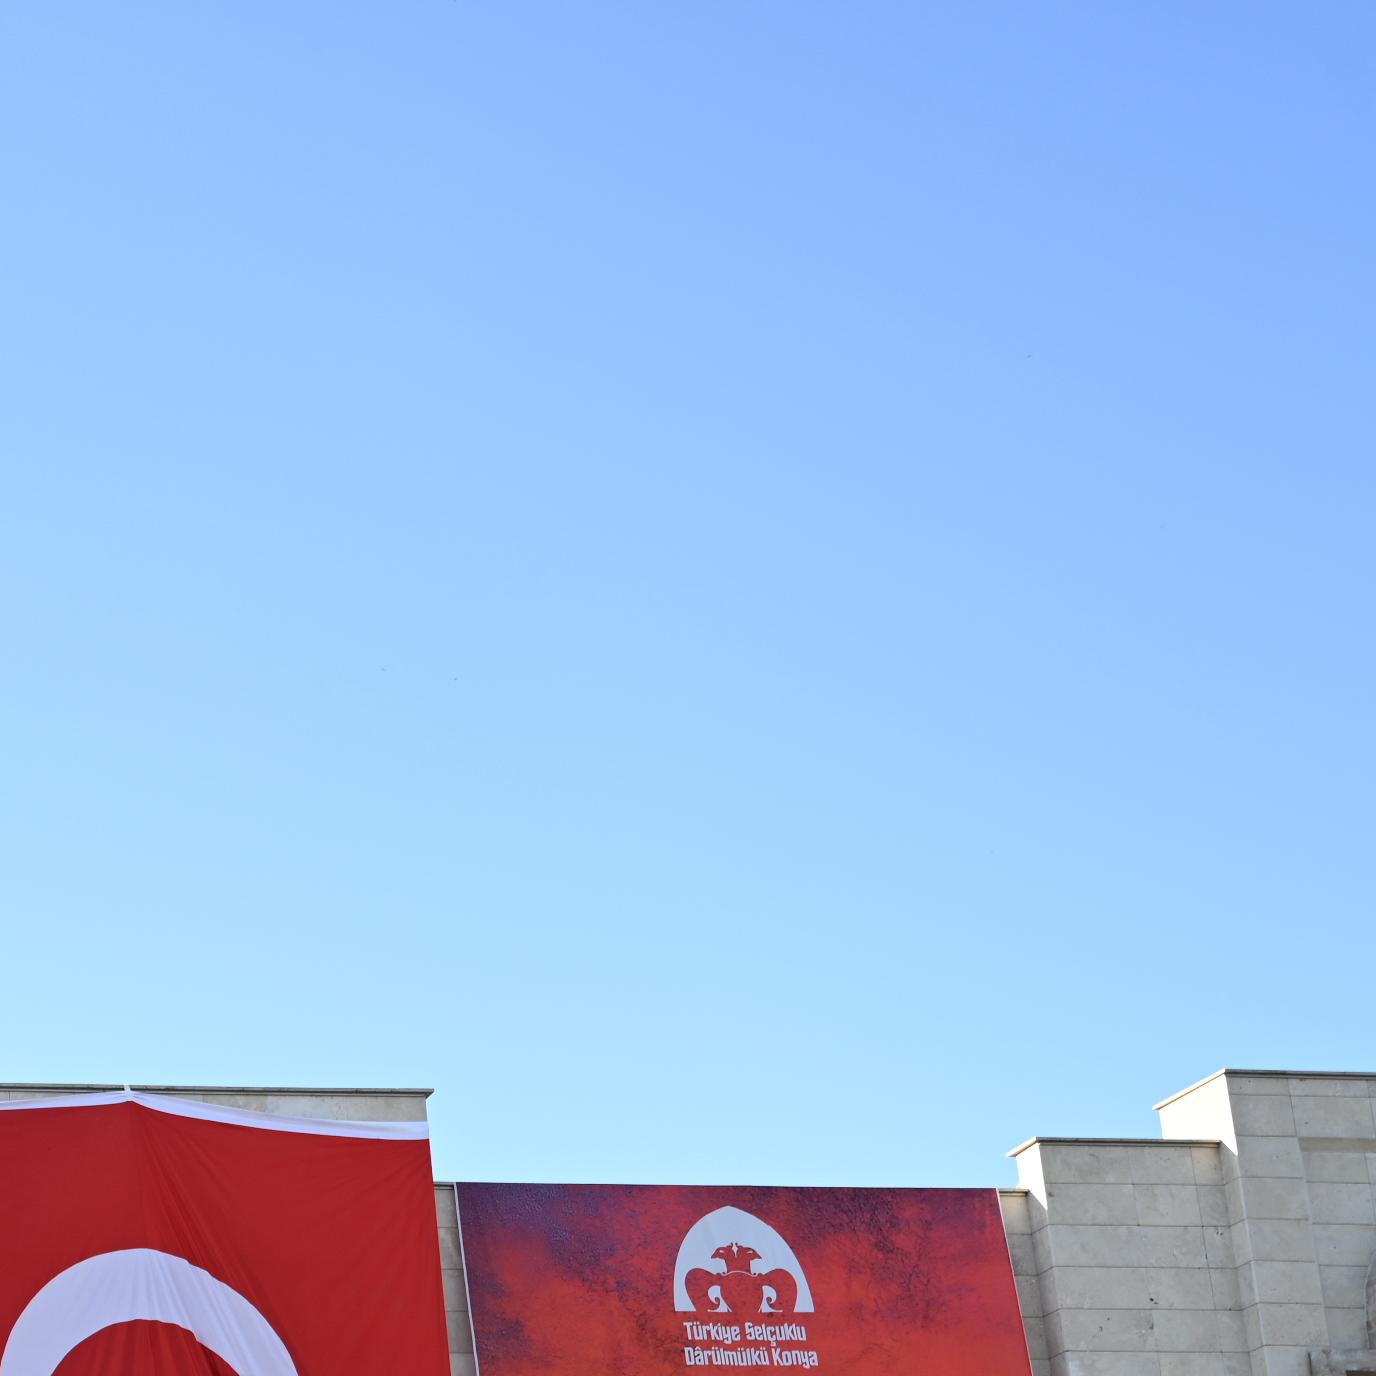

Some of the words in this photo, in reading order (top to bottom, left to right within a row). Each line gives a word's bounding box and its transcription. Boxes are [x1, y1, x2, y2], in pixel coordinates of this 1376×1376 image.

[683, 1322, 741, 1344] Türkiye
[744, 1322, 807, 1346] Selçuklu
[684, 1346, 770, 1366] Dârülmülkü
[771, 1347, 819, 1368] Konya
